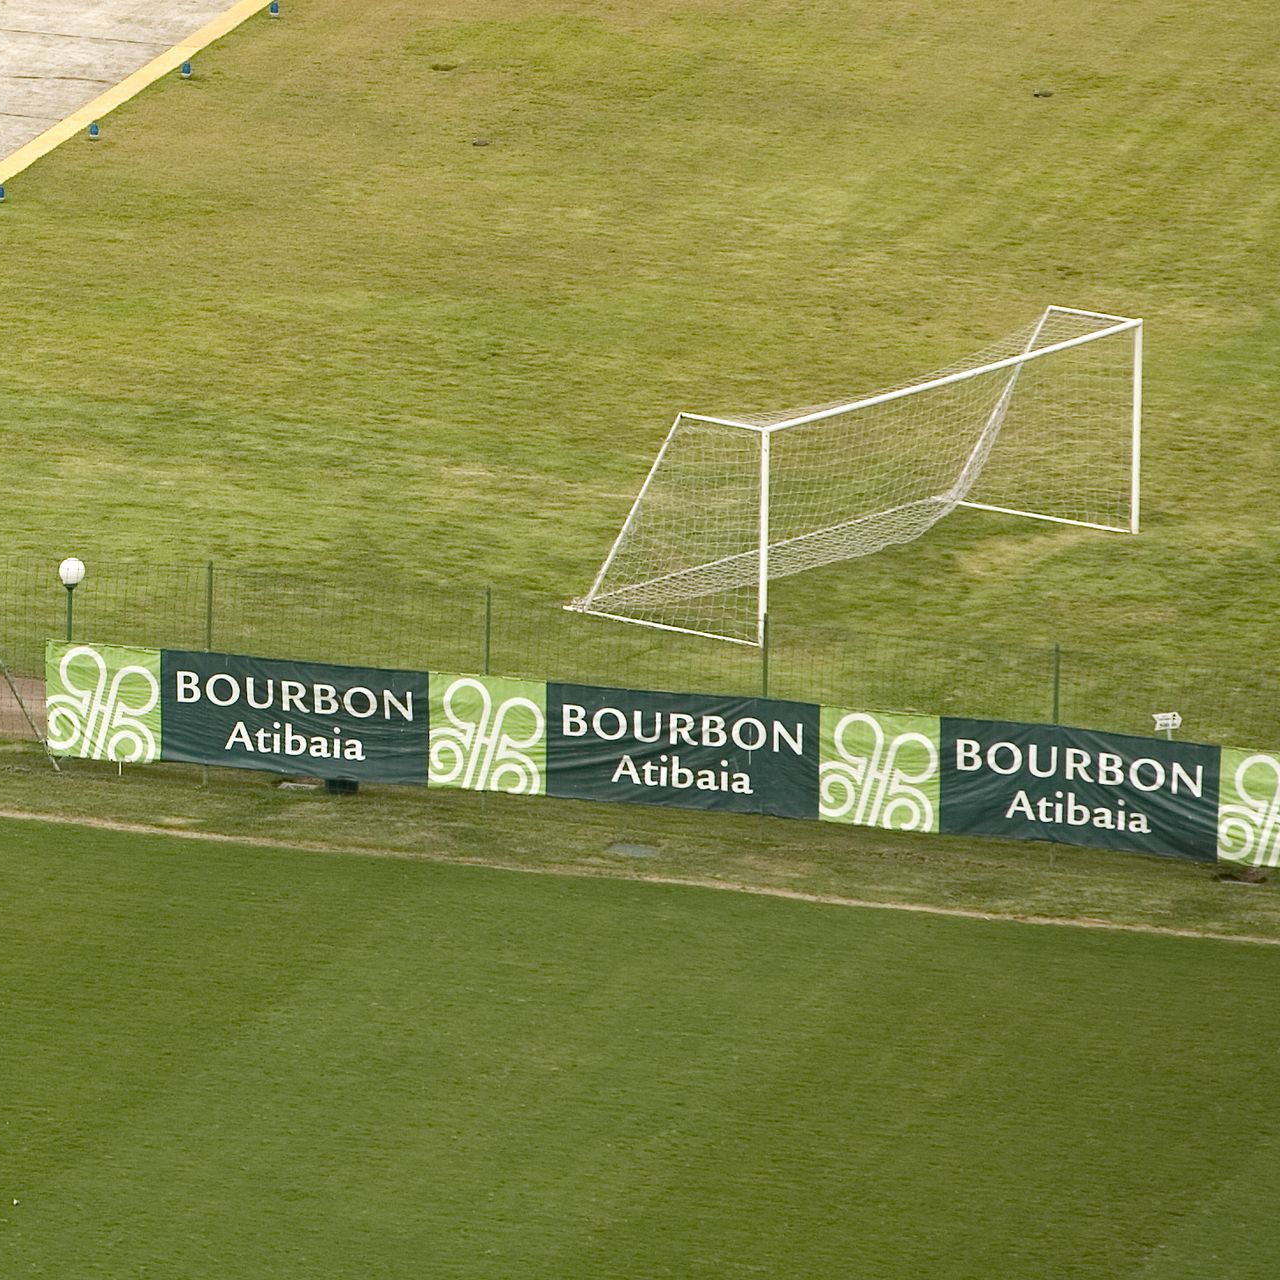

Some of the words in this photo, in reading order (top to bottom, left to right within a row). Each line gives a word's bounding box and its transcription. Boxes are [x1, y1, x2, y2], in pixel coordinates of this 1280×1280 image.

[176, 670, 414, 722] BOURBON
[224, 721, 366, 761] Atibaia
[562, 703, 804, 756] BOURBON
[611, 754, 754, 795] Atibaia
[956, 738, 1204, 798] BOURBON
[1005, 790, 1152, 834] Atibaia
